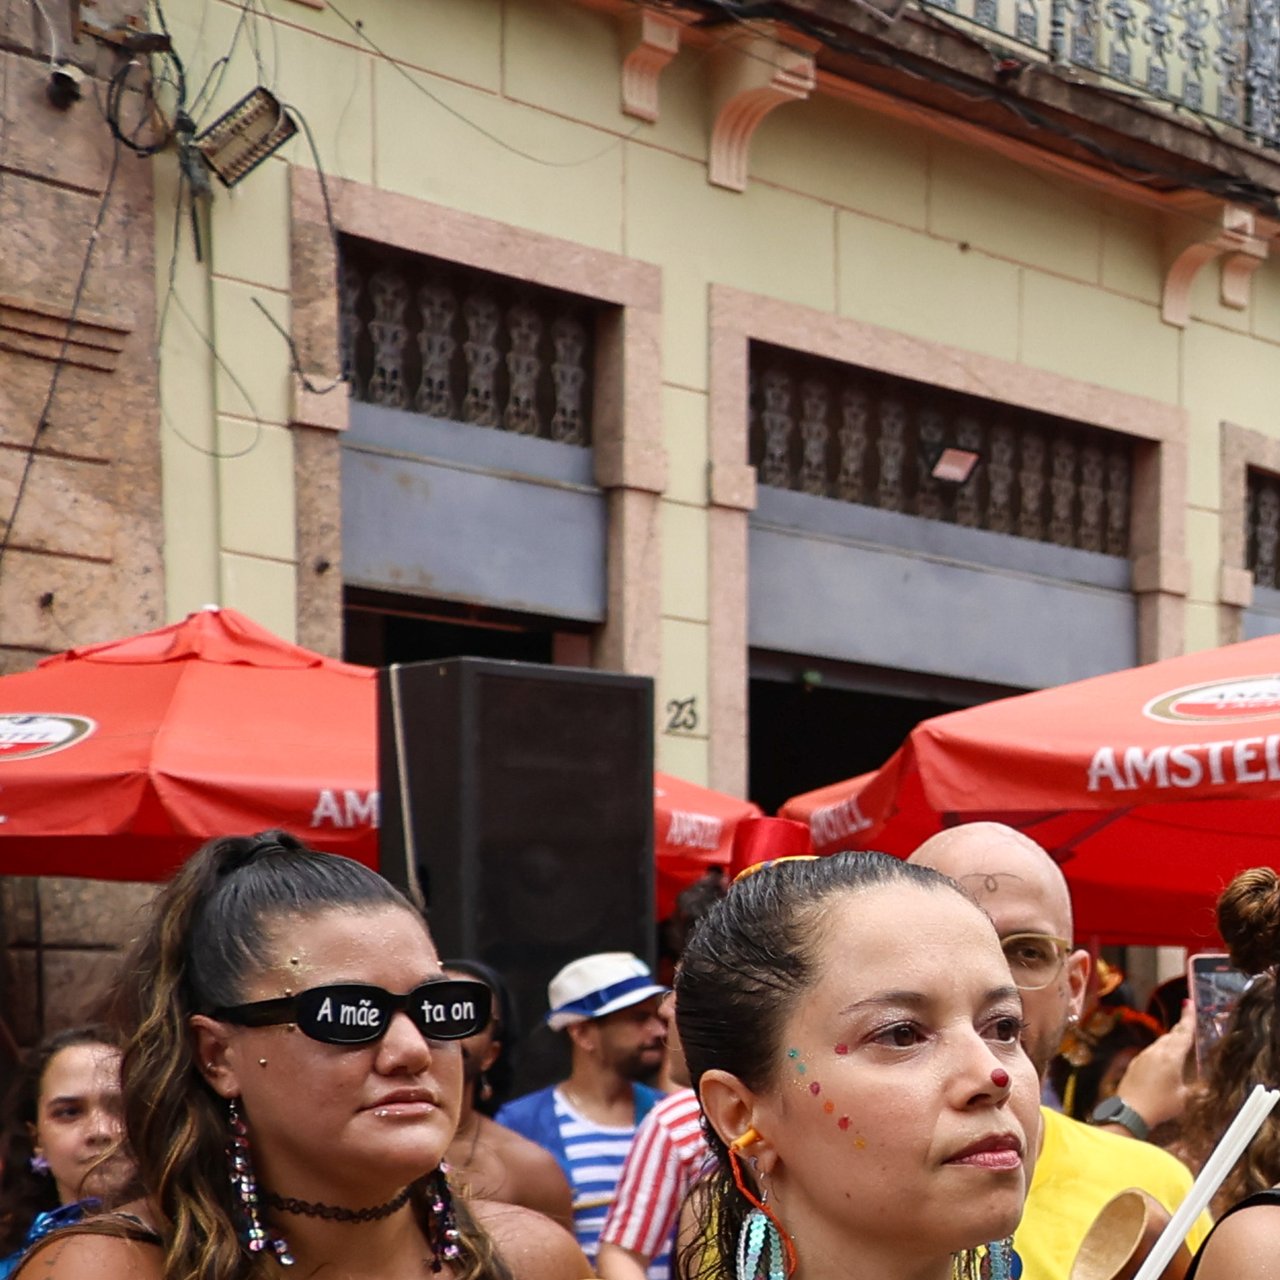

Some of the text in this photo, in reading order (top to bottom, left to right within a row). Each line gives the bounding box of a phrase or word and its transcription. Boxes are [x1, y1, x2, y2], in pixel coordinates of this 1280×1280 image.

[666, 697, 697, 730] 23
[316, 997, 475, 1027] A mãe ta on
